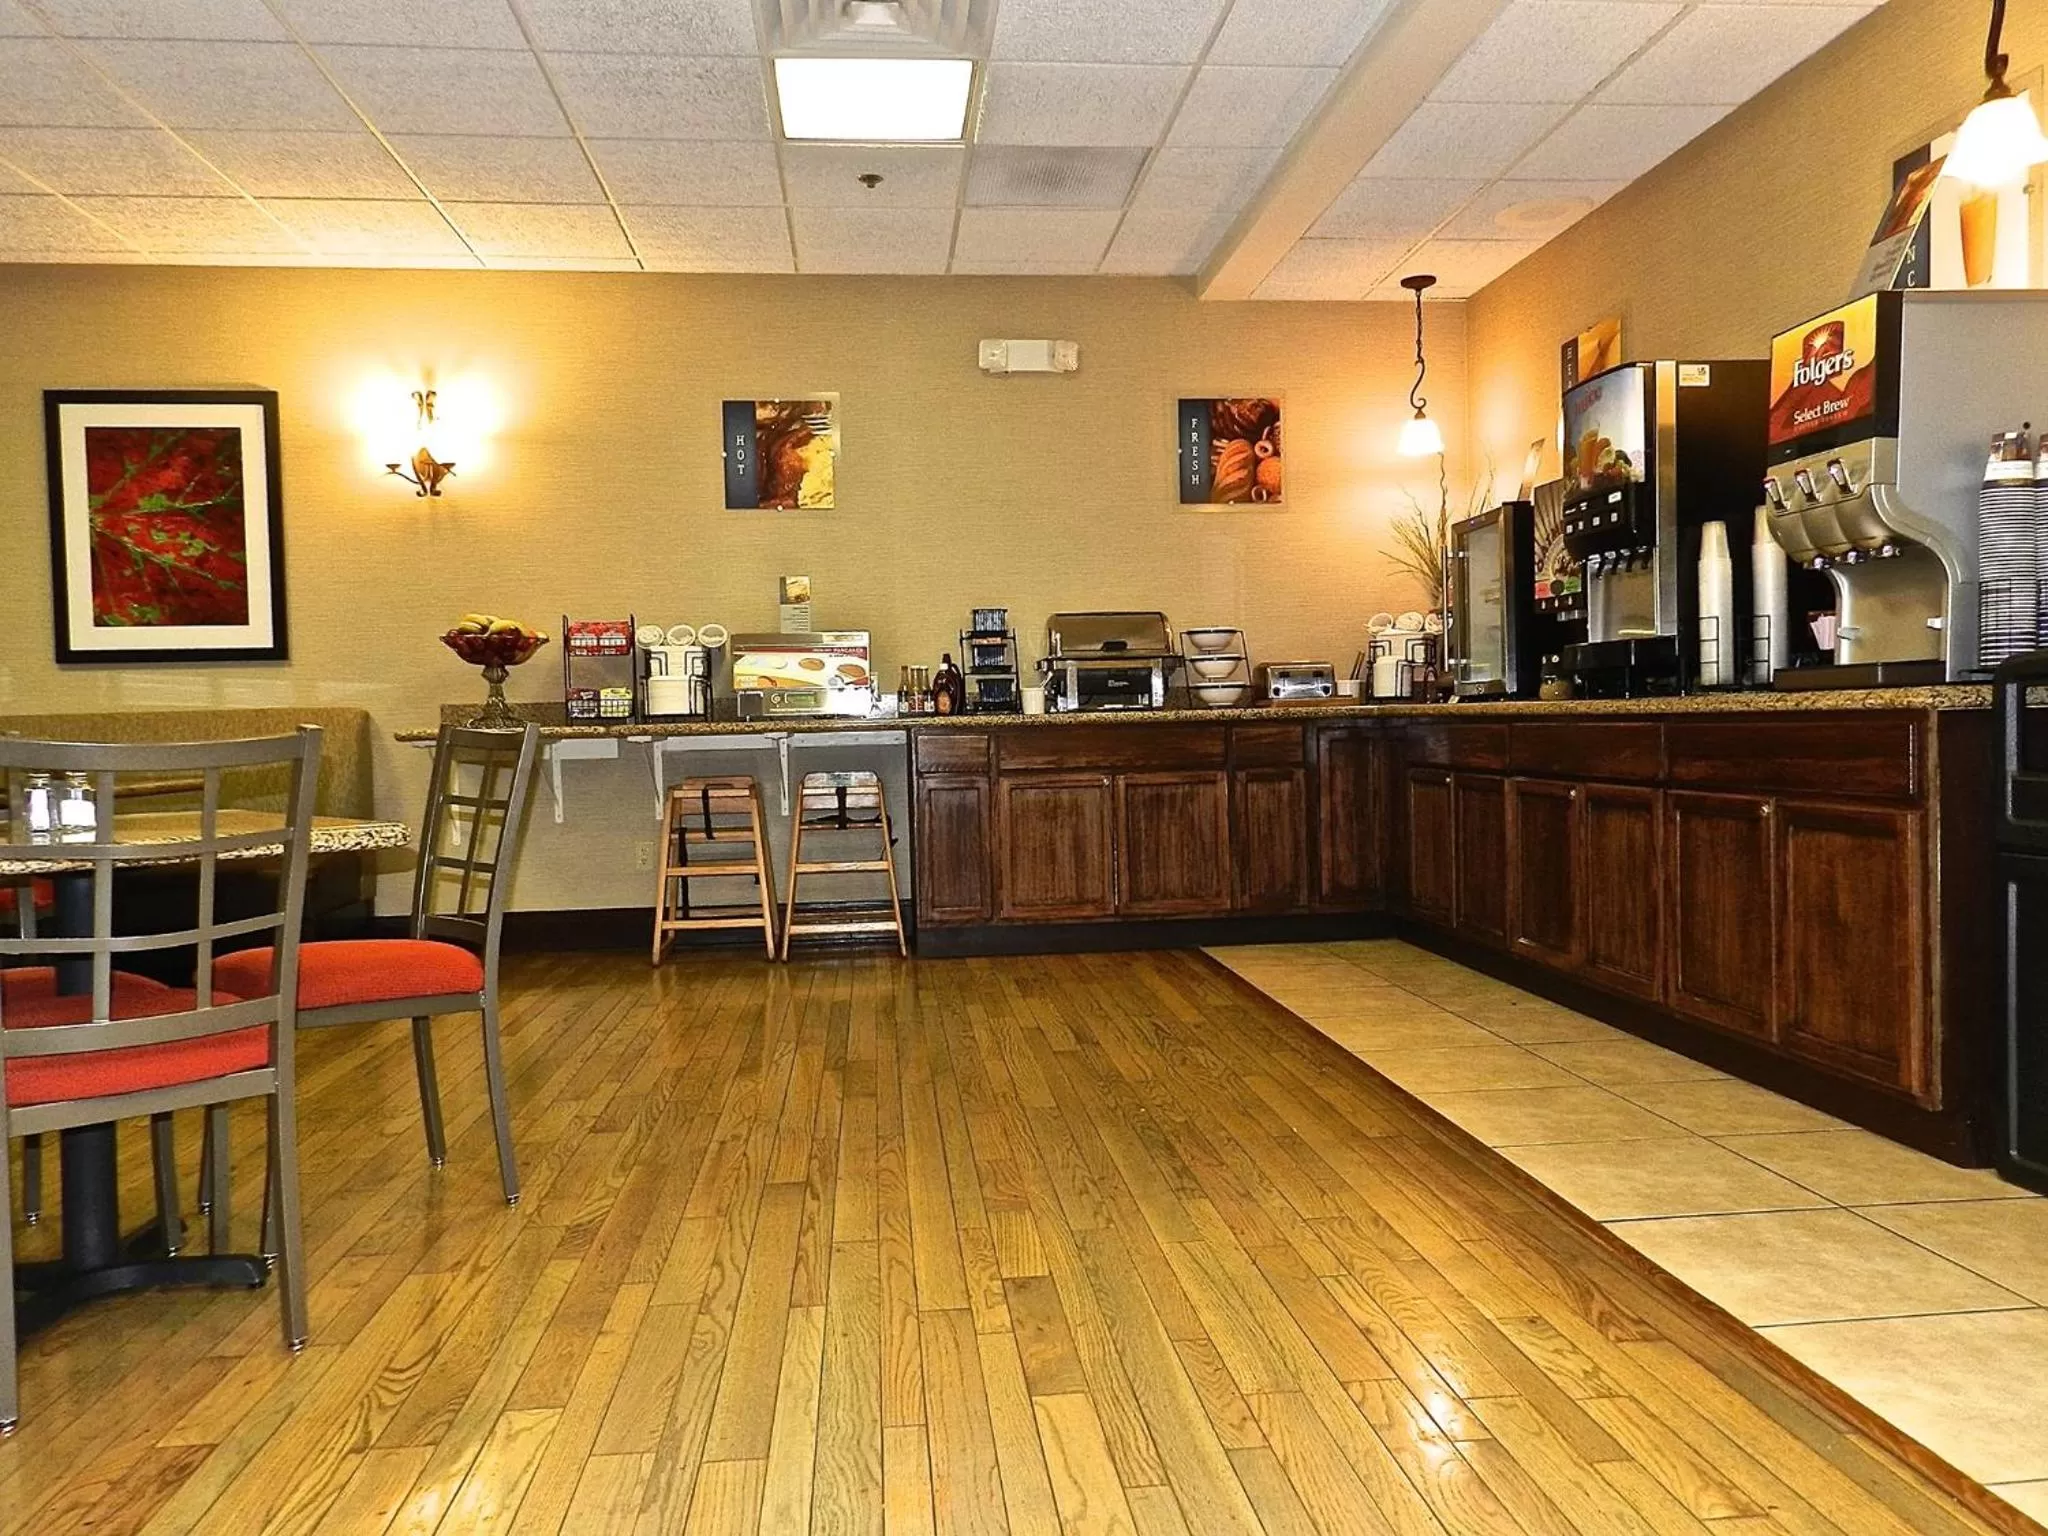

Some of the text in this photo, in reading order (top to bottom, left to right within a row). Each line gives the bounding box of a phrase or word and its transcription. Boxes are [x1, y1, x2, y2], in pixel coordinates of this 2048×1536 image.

[1793, 350, 1855, 388] Folgers
[1793, 398, 1850, 425] Select Brew
[736, 434, 745, 475] HOT
[1191, 418, 1199, 485] FRESH
